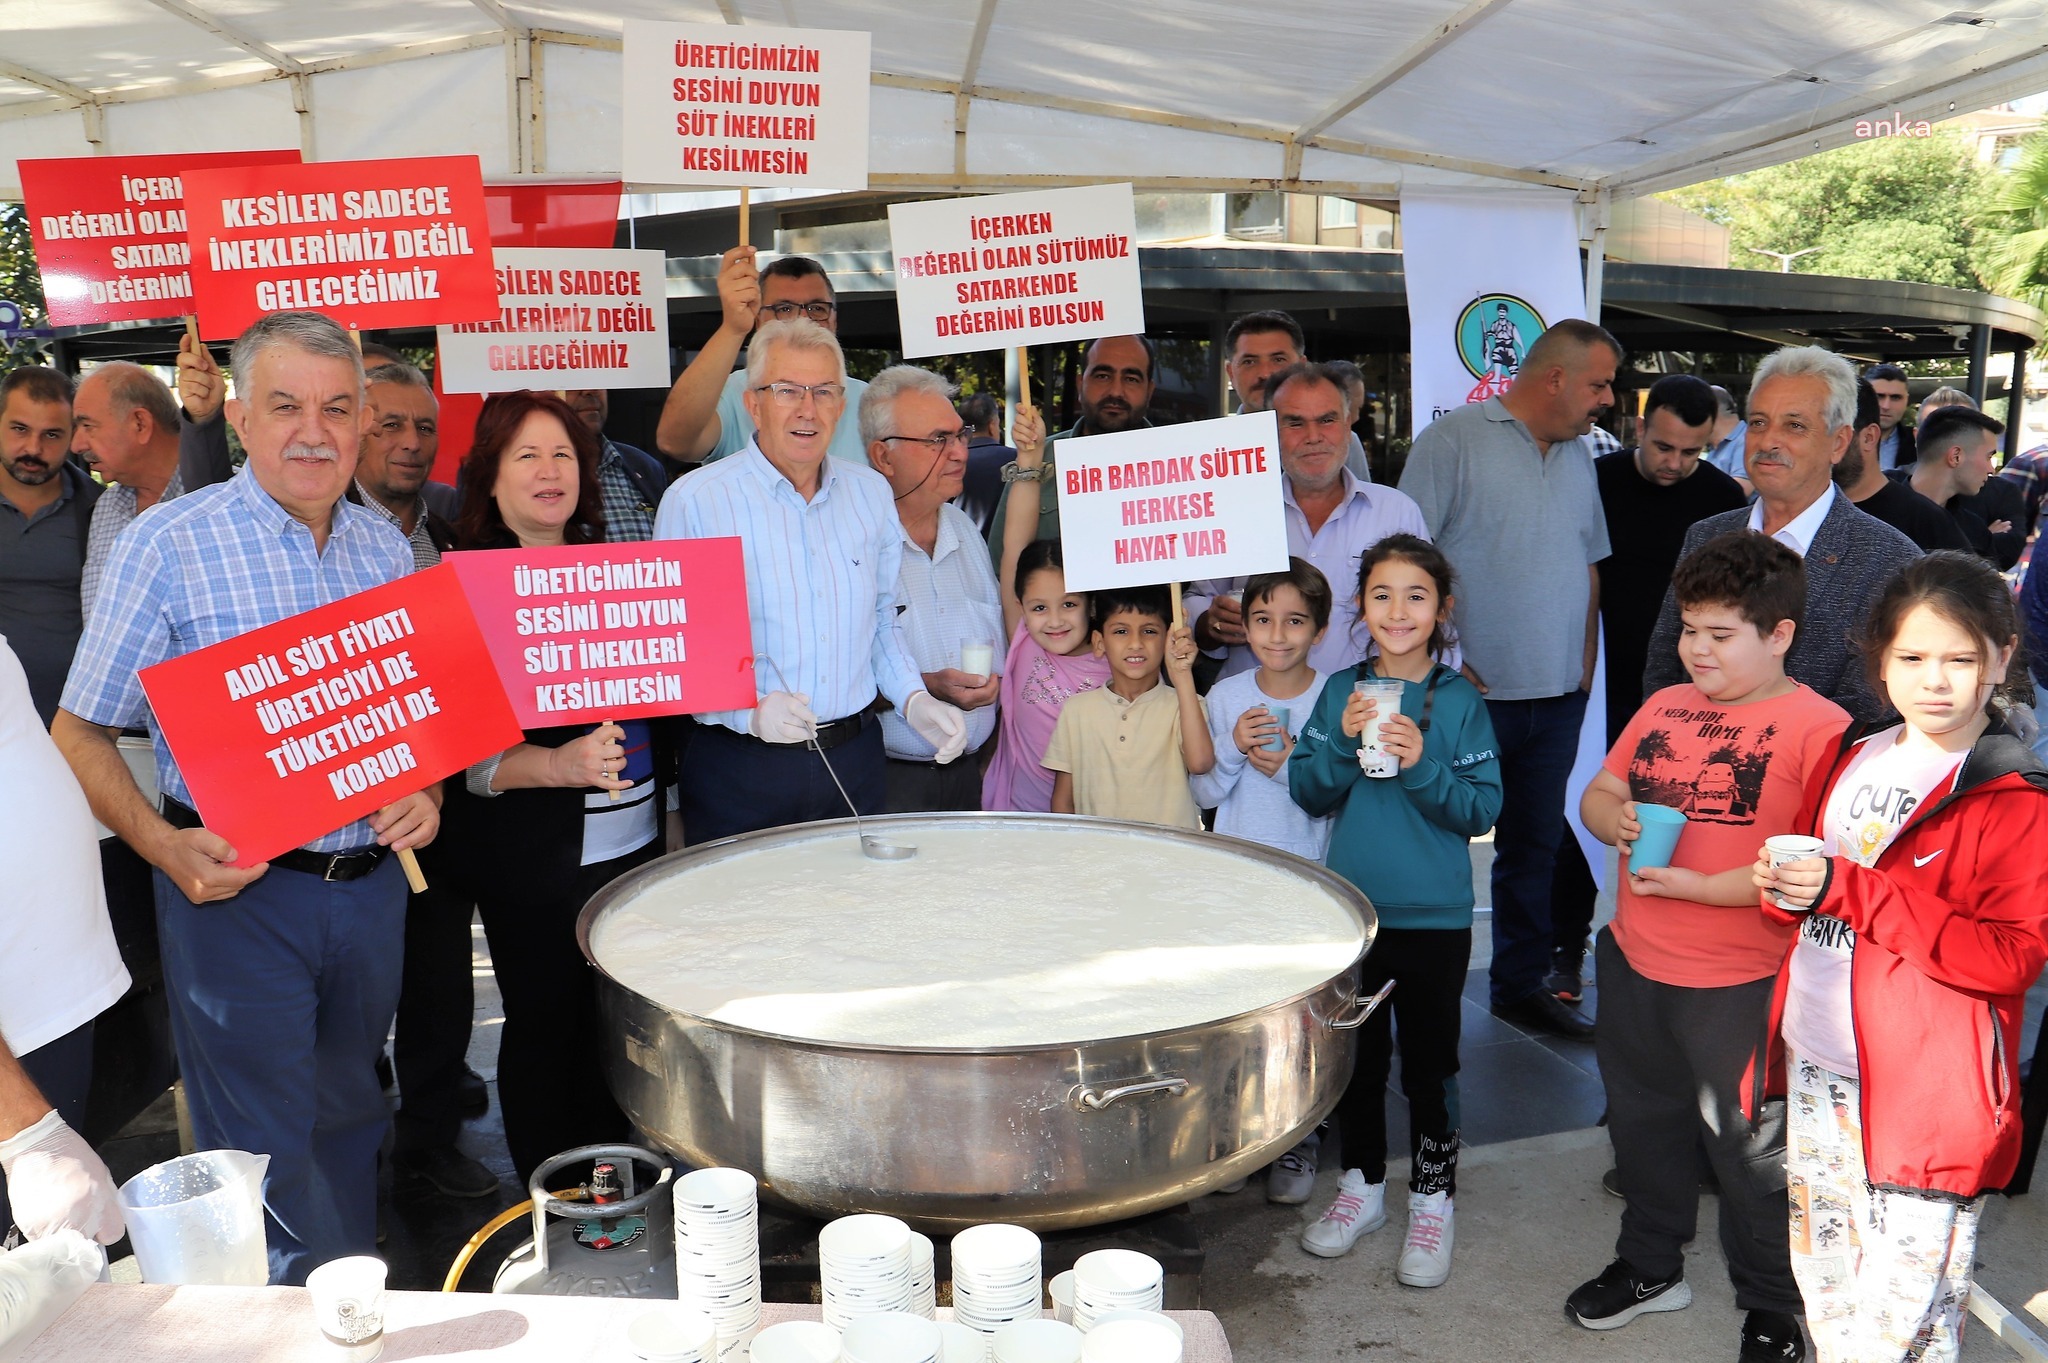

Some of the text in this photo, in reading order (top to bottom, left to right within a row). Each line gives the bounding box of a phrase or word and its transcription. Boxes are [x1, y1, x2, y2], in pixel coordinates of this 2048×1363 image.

[675, 40, 819, 72] ÜRETİCİMİZİN
[673, 76, 820, 107] SESİNİ DUYUN
[677, 109, 815, 140] SÜT İNEKLERİ
[683, 145, 808, 174] KESİLMESİN
[222, 186, 451, 228] KESİLEN SADECE
[41, 208, 136, 240] DEĞERLİ
[970, 212, 1052, 243] İÇERKEN
[208, 222, 474, 271] İNEKLERİMİZ DEĞİL
[900, 234, 1129, 279] DEĞERLİ OLAN SÜTÜMÜZ
[91, 271, 193, 304] DEĞERİNİ
[256, 266, 440, 311] GELECEĞİMİZ
[559, 270, 641, 295] SADECE
[957, 272, 1078, 304] SATARKENDE
[597, 302, 656, 333] DEĞİL
[936, 300, 1104, 337] DEĞERİNİ BULSUN
[488, 339, 628, 371] GELECEĞİMİZ
[1066, 447, 1267, 495] BİR BARDAK SÜTTE
[1122, 492, 1215, 526] HERKESE
[1115, 529, 1227, 564] HAYAT VAR
[514, 557, 682, 597] ÜRETİCİMİZİN
[515, 598, 687, 635] SESİNİ DUYUN
[224, 607, 415, 701] ADİL SÜT FİYATI
[524, 632, 686, 674] SÜT İNEKLERİ
[256, 651, 418, 735] ÜRETİCİYİ DE
[536, 672, 682, 712] KESİLMESİN
[266, 686, 441, 778] TÜKETİCİYİ DE
[1693, 710, 1727, 724] RIDE
[1697, 723, 1746, 740] HOME
[1461, 753, 1474, 765] go
[1475, 749, 1494, 760] Let
[327, 742, 417, 801] KORUR
[1421, 1133, 1437, 1152] you
